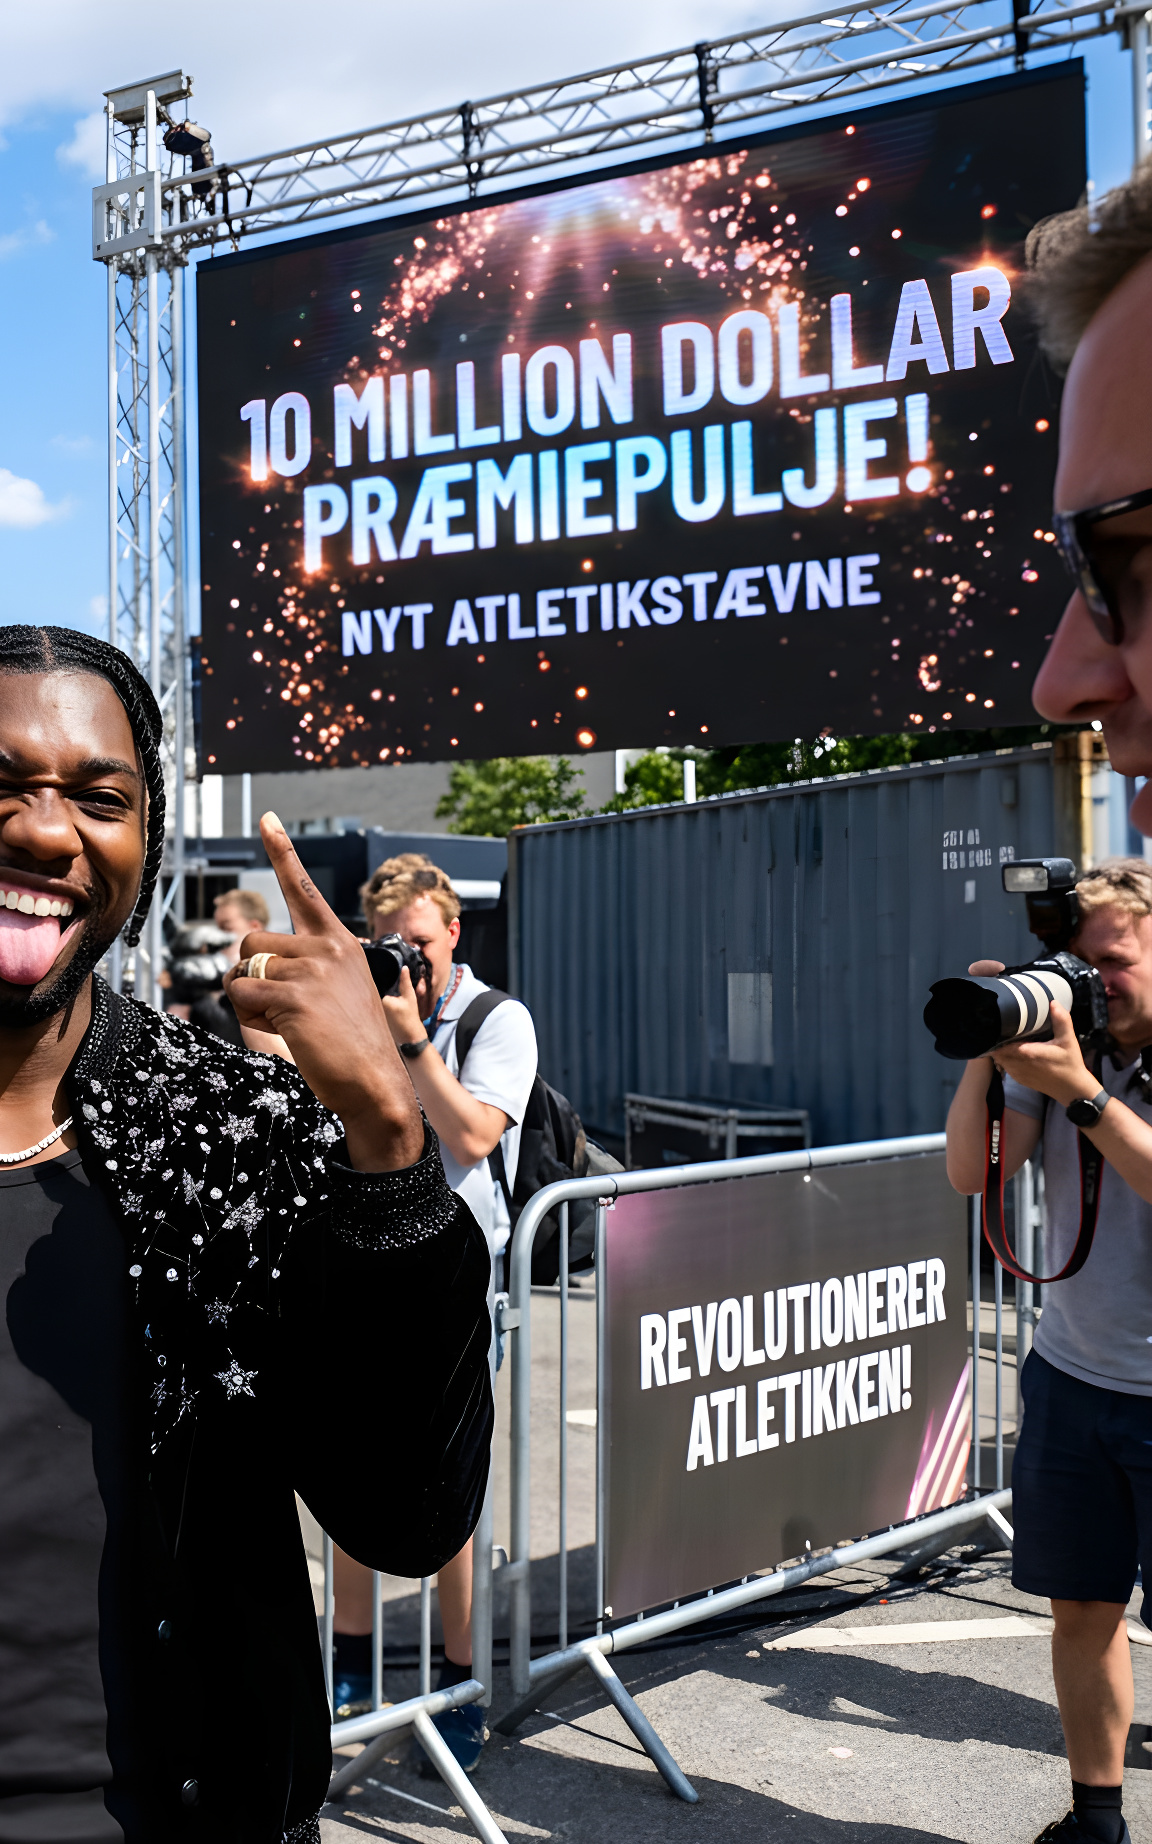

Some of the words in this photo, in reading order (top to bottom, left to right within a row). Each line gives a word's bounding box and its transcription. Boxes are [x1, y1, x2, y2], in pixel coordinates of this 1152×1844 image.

[240, 391, 312, 482] 10
[333, 332, 633, 468] MILLION
[661, 266, 1014, 416] DOLLAR
[303, 393, 933, 573] PRÆMIEPULJE!
[341, 603, 434, 657] NYT
[445, 553, 881, 648] ATLETIKSTÆVNE
[640, 1257, 947, 1391] REVOLUTIONERER
[686, 1344, 912, 1472] ATLETIKKEN!
